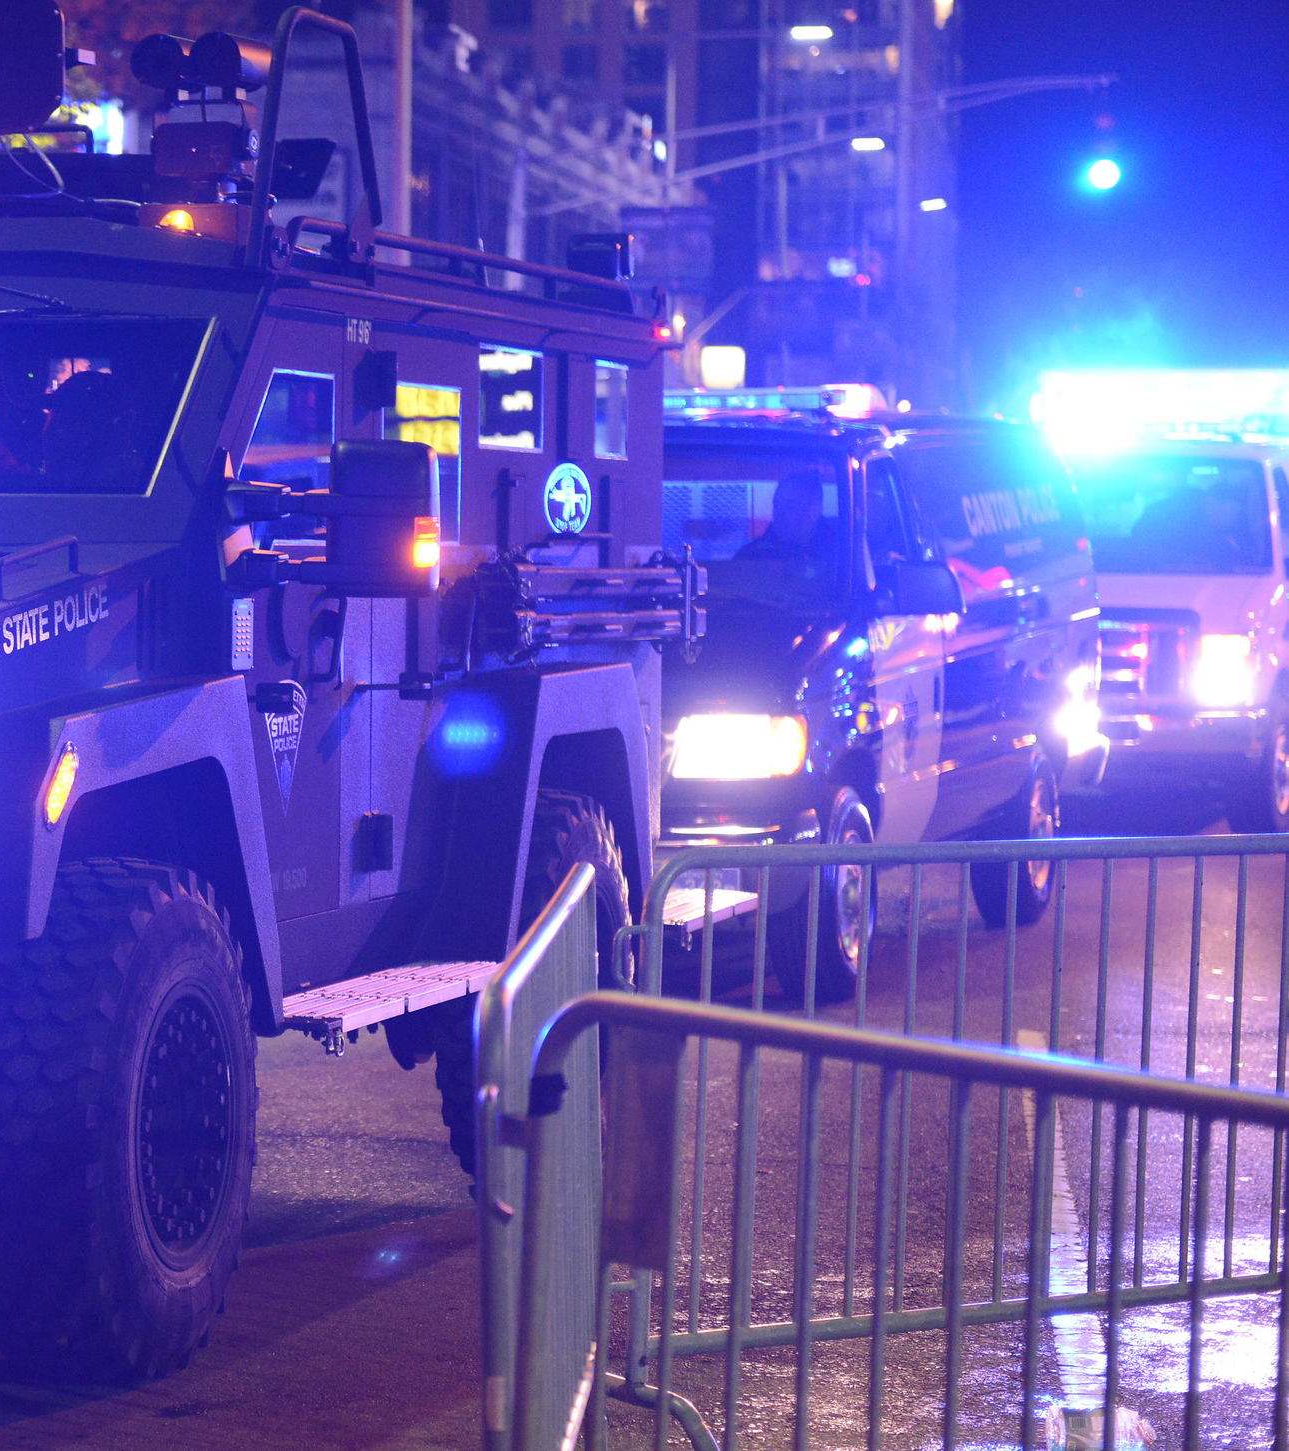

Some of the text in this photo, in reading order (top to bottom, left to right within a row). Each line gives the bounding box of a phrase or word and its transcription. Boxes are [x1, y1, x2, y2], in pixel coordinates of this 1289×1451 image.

[347, 318, 358, 342] HT
[961, 484, 1061, 537] CANTON POLICE
[2, 584, 109, 655] STATE POLICE
[271, 714, 299, 738] STATE
[273, 735, 297, 752] POLICE
